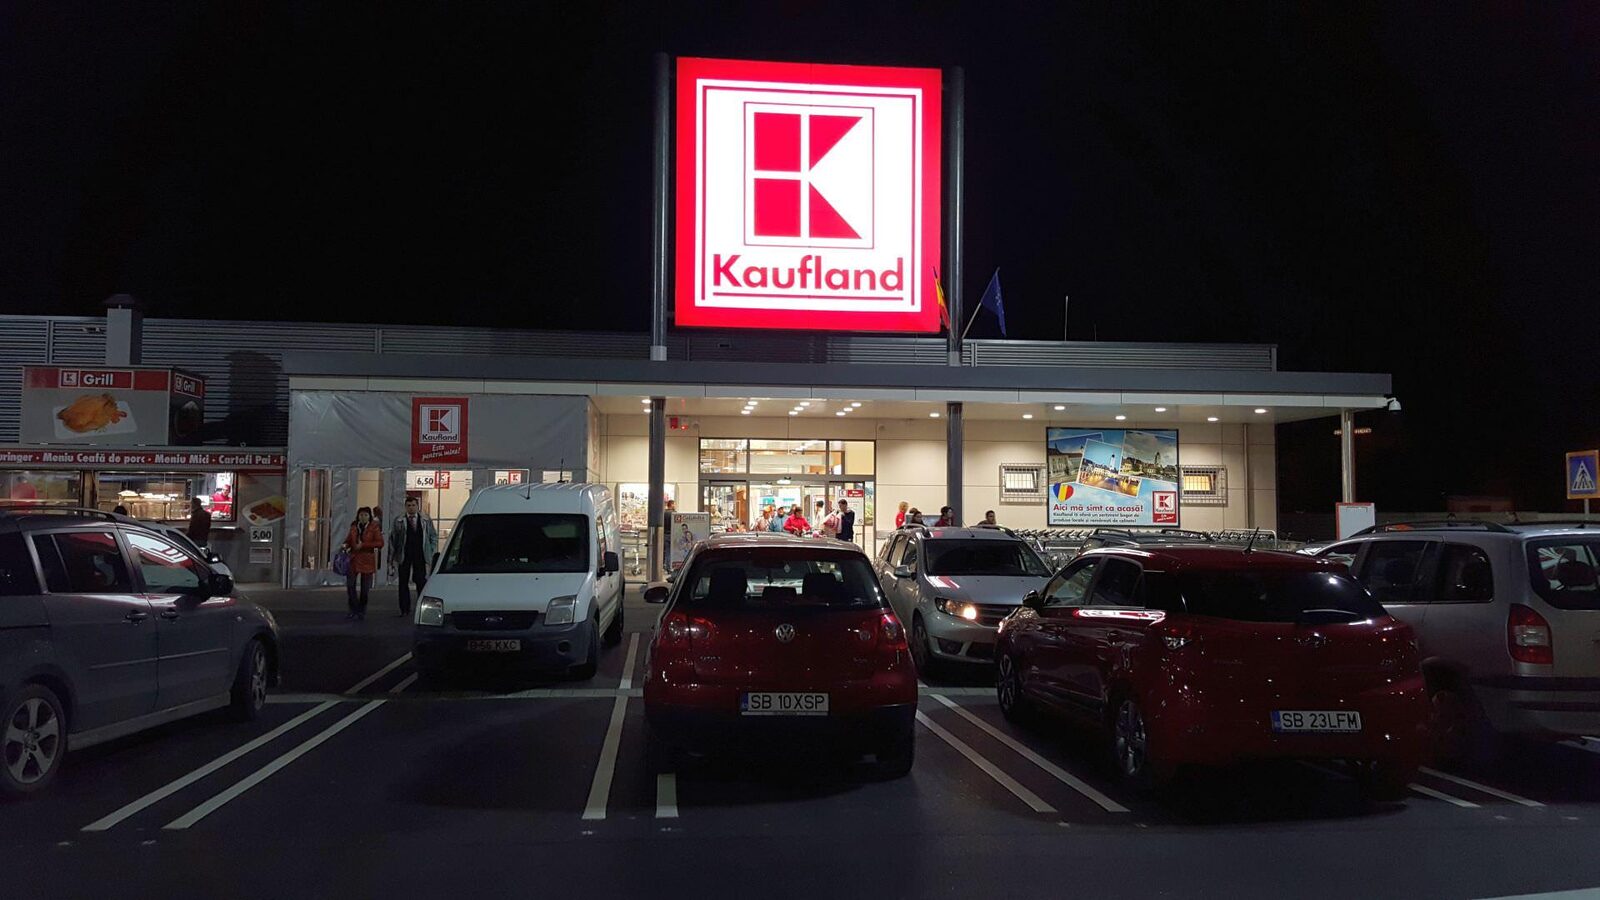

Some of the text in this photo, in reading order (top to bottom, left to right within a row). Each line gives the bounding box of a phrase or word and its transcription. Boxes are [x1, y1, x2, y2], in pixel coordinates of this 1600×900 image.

[712, 253, 904, 292] Kaufland
[83, 373, 113, 386] Grill
[184, 380, 196, 393] Grill
[422, 433, 458, 441] Kaufland
[43, 452, 74, 463] Meniu
[77, 452, 106, 463] Ceafă
[109, 453, 122, 463] de
[124, 454, 146, 465] porc
[155, 453, 187, 464] Meniu
[189, 453, 209, 464] Mici
[219, 454, 252, 465] Cartofi
[255, 455, 271, 465] Pai
[416, 477, 434, 486] 6,50
[1053, 503, 1068, 511] Aici
[1070, 504, 1084, 512] mă
[1086, 504, 1103, 512] simt
[1116, 504, 1144, 512] acasă!
[252, 530, 272, 540] 5,00
[496, 640, 517, 649] KXC
[751, 694, 772, 709] SB
[1282, 712, 1304, 728] SB
